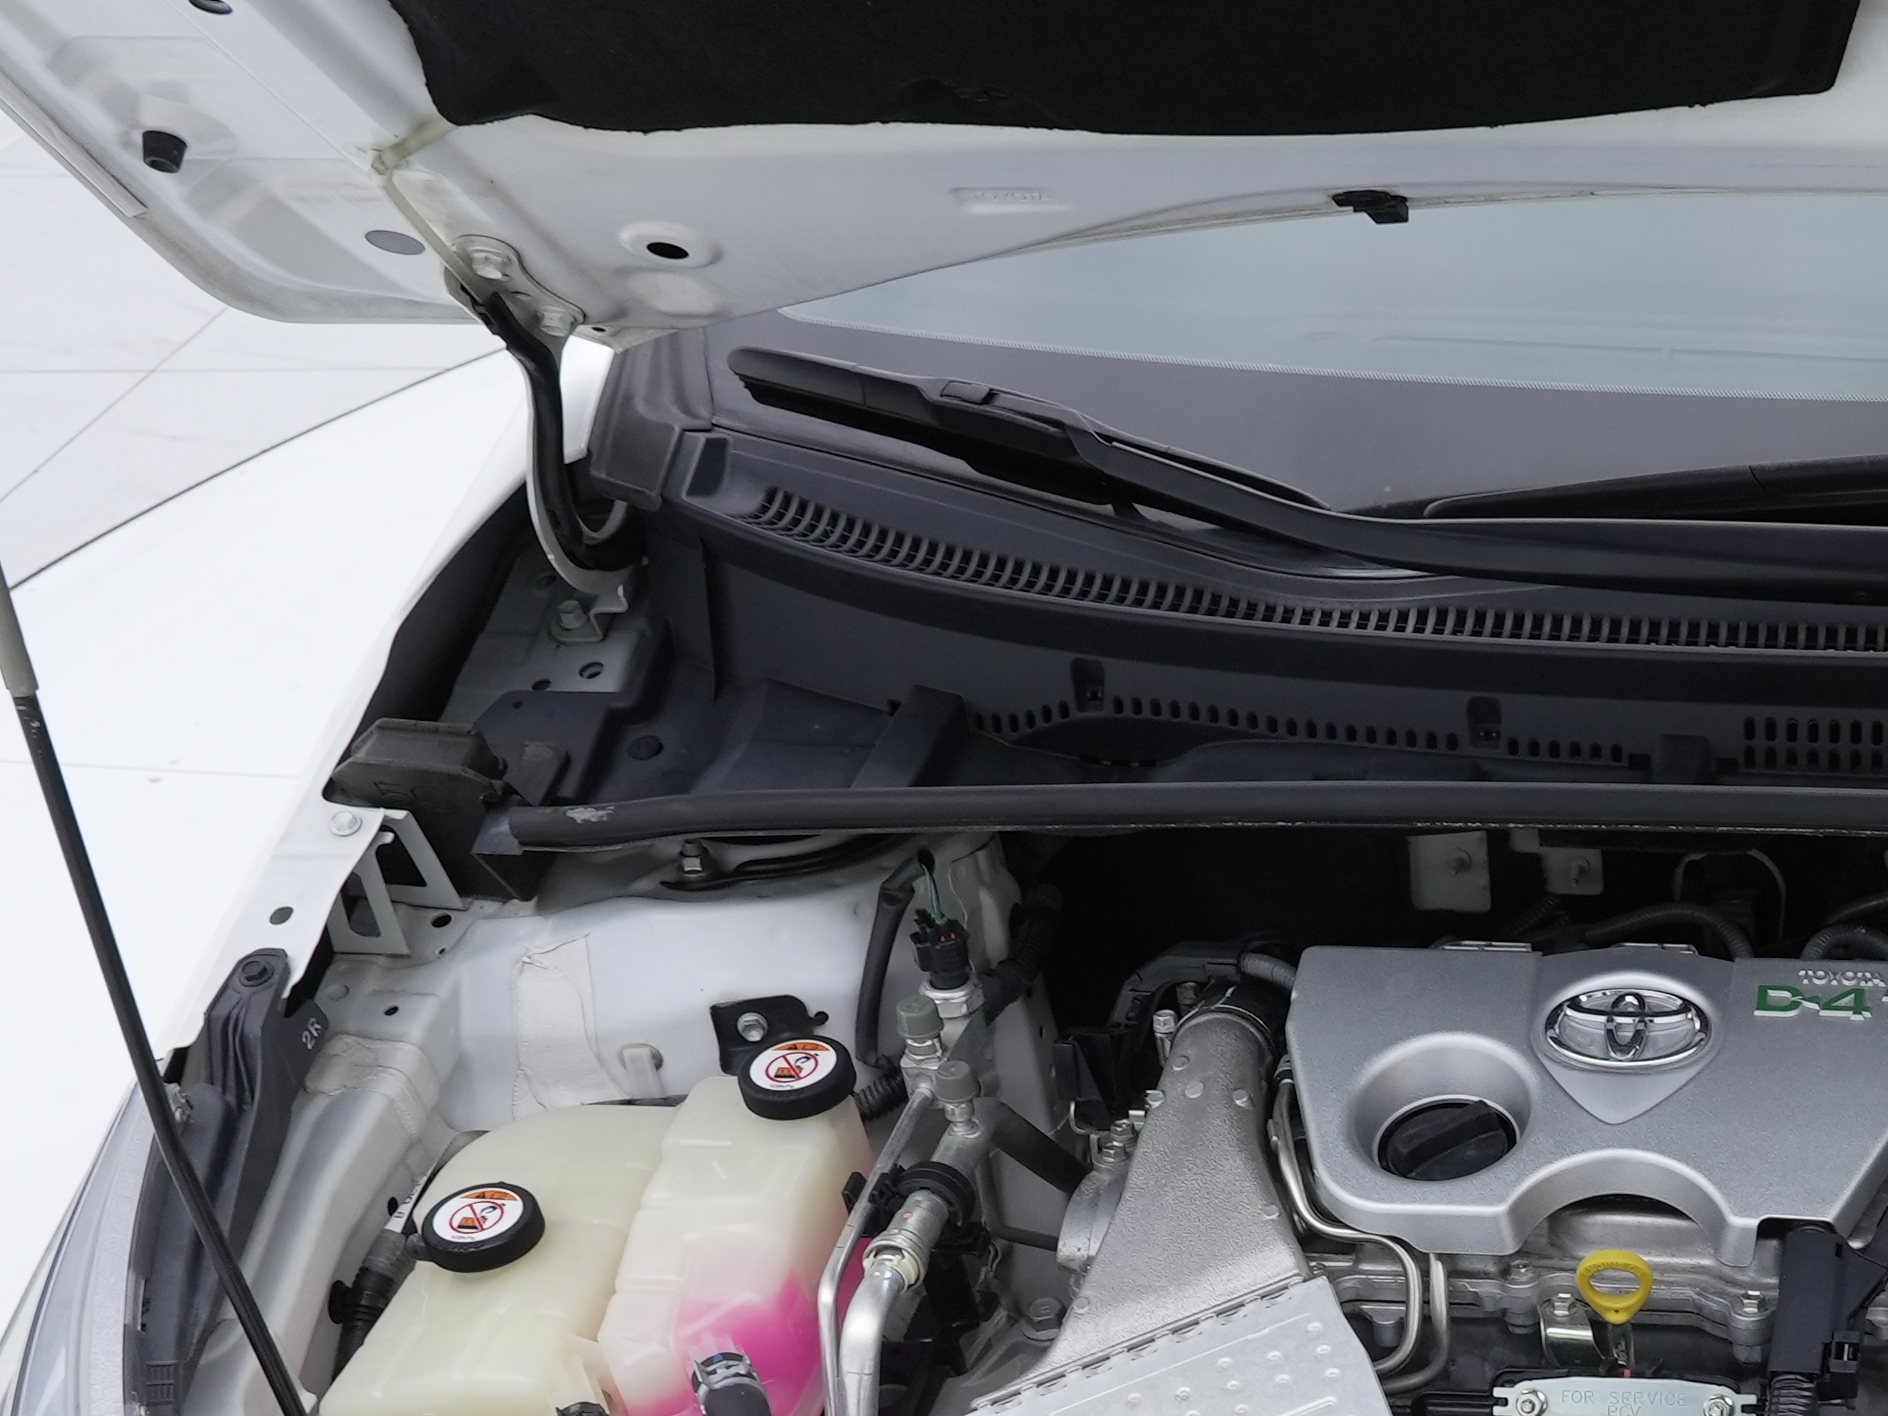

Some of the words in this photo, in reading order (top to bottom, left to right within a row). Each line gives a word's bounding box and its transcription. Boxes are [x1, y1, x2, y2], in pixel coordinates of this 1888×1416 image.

[1798, 969, 1887, 987] TOYOTA
[301, 1017, 322, 1050] 2R
[1561, 1389, 1594, 1404] FOR
[1609, 1391, 1687, 1406] SERVICE
